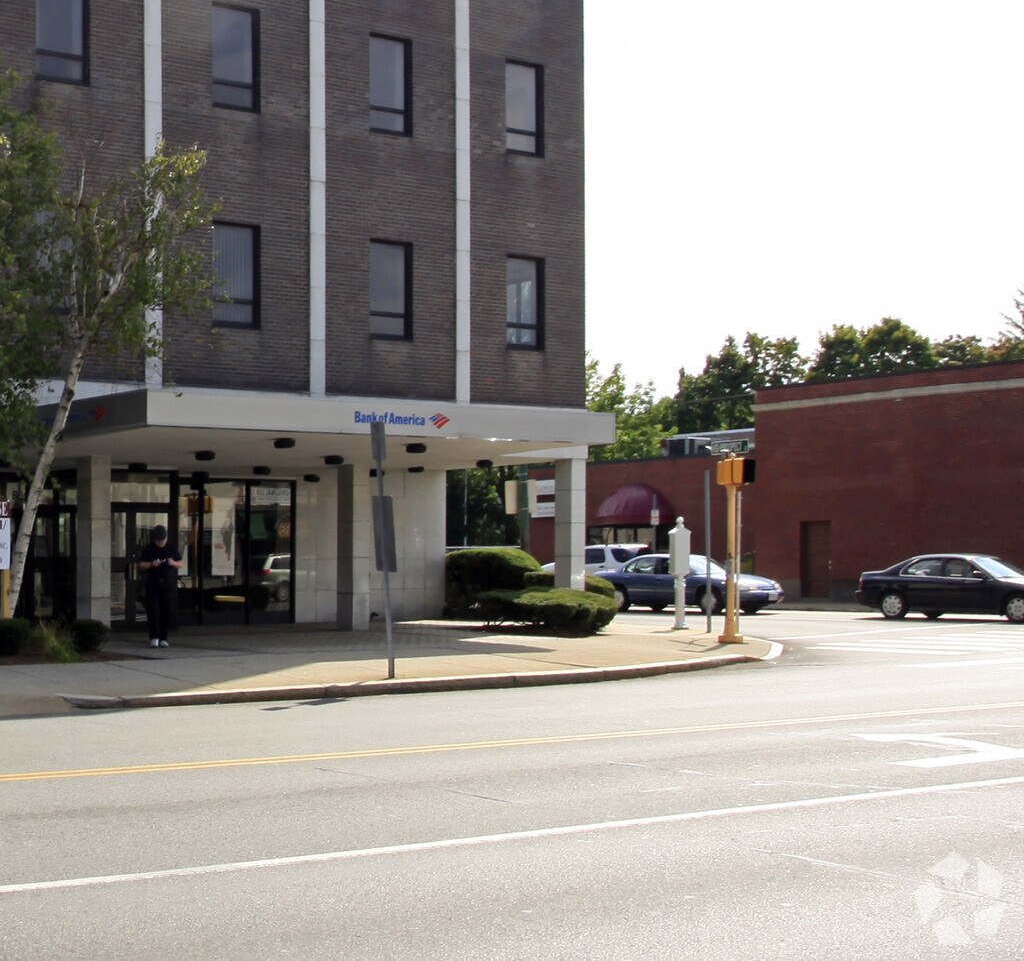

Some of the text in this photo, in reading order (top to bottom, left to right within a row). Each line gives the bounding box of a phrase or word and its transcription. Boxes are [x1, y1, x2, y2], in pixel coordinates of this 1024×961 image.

[354, 410, 426, 426] Bank of America
